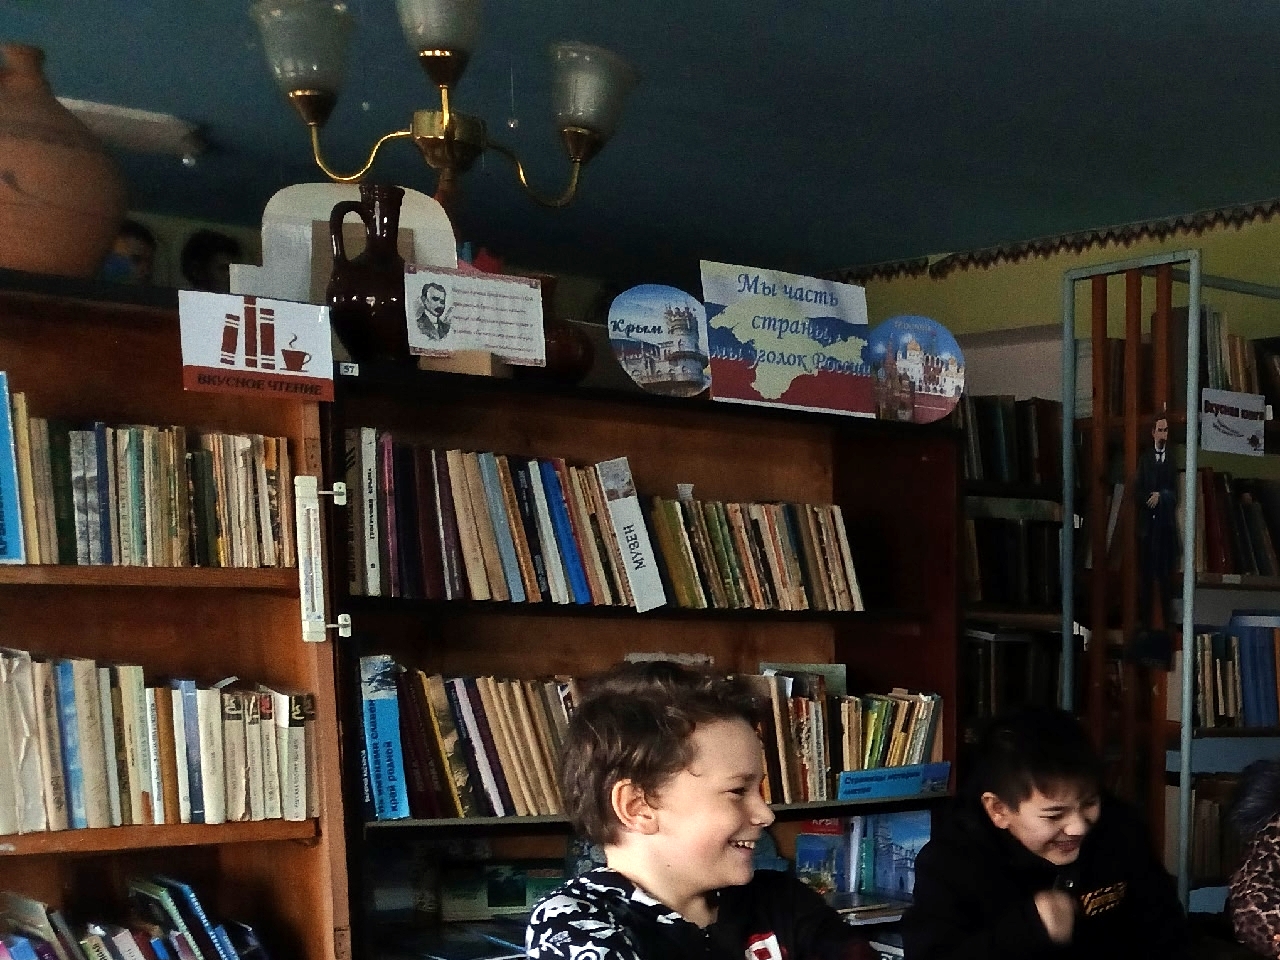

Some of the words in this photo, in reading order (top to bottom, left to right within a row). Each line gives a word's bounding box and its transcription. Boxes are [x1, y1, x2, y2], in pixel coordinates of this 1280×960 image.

[737, 273, 777, 297] Мы
[783, 285, 839, 307] часть
[610, 317, 663, 336] Крым
[197, 374, 264, 391] ВКУСНОЕ
[267, 379, 323, 395] ЧТЕНИЕ
